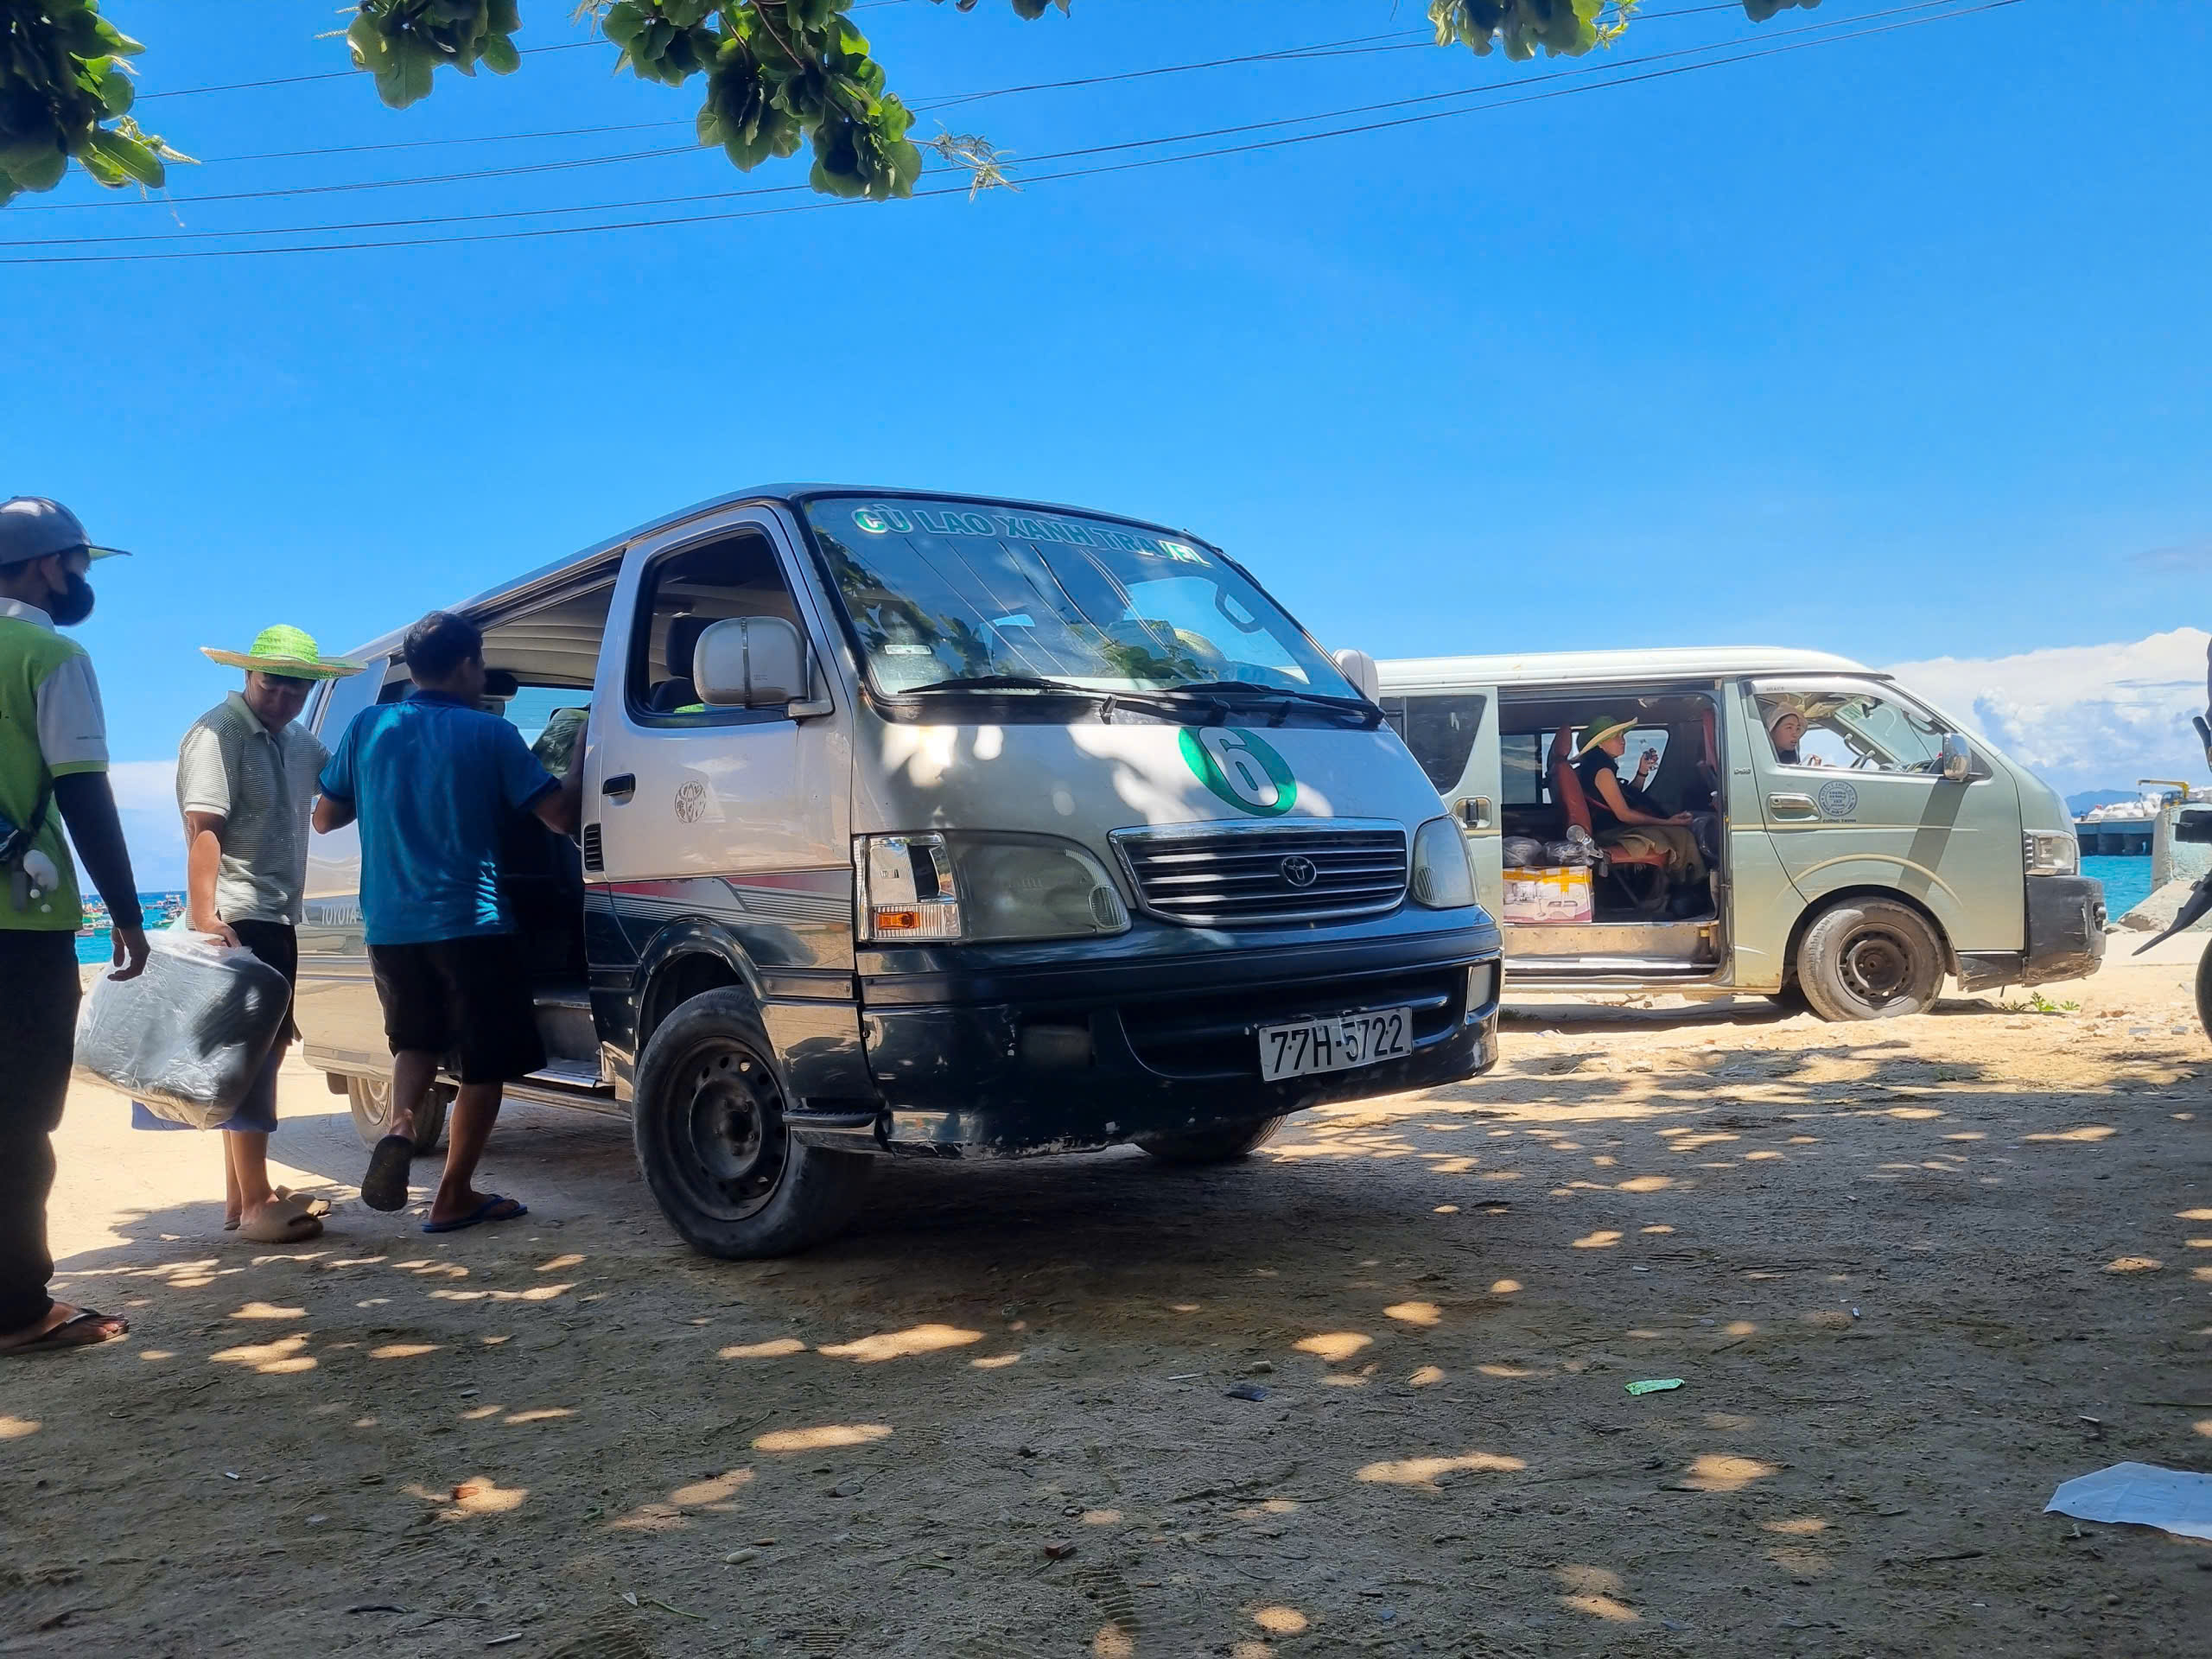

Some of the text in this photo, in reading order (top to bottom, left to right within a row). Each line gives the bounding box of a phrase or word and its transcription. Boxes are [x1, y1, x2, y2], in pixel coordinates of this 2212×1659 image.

[912, 510, 997, 537] LAO
[990, 515, 1098, 546] XANH
[1198, 727, 1281, 807] 6
[321, 906, 357, 925] TOYOTA
[1270, 1014, 1403, 1073] 77H-5722
